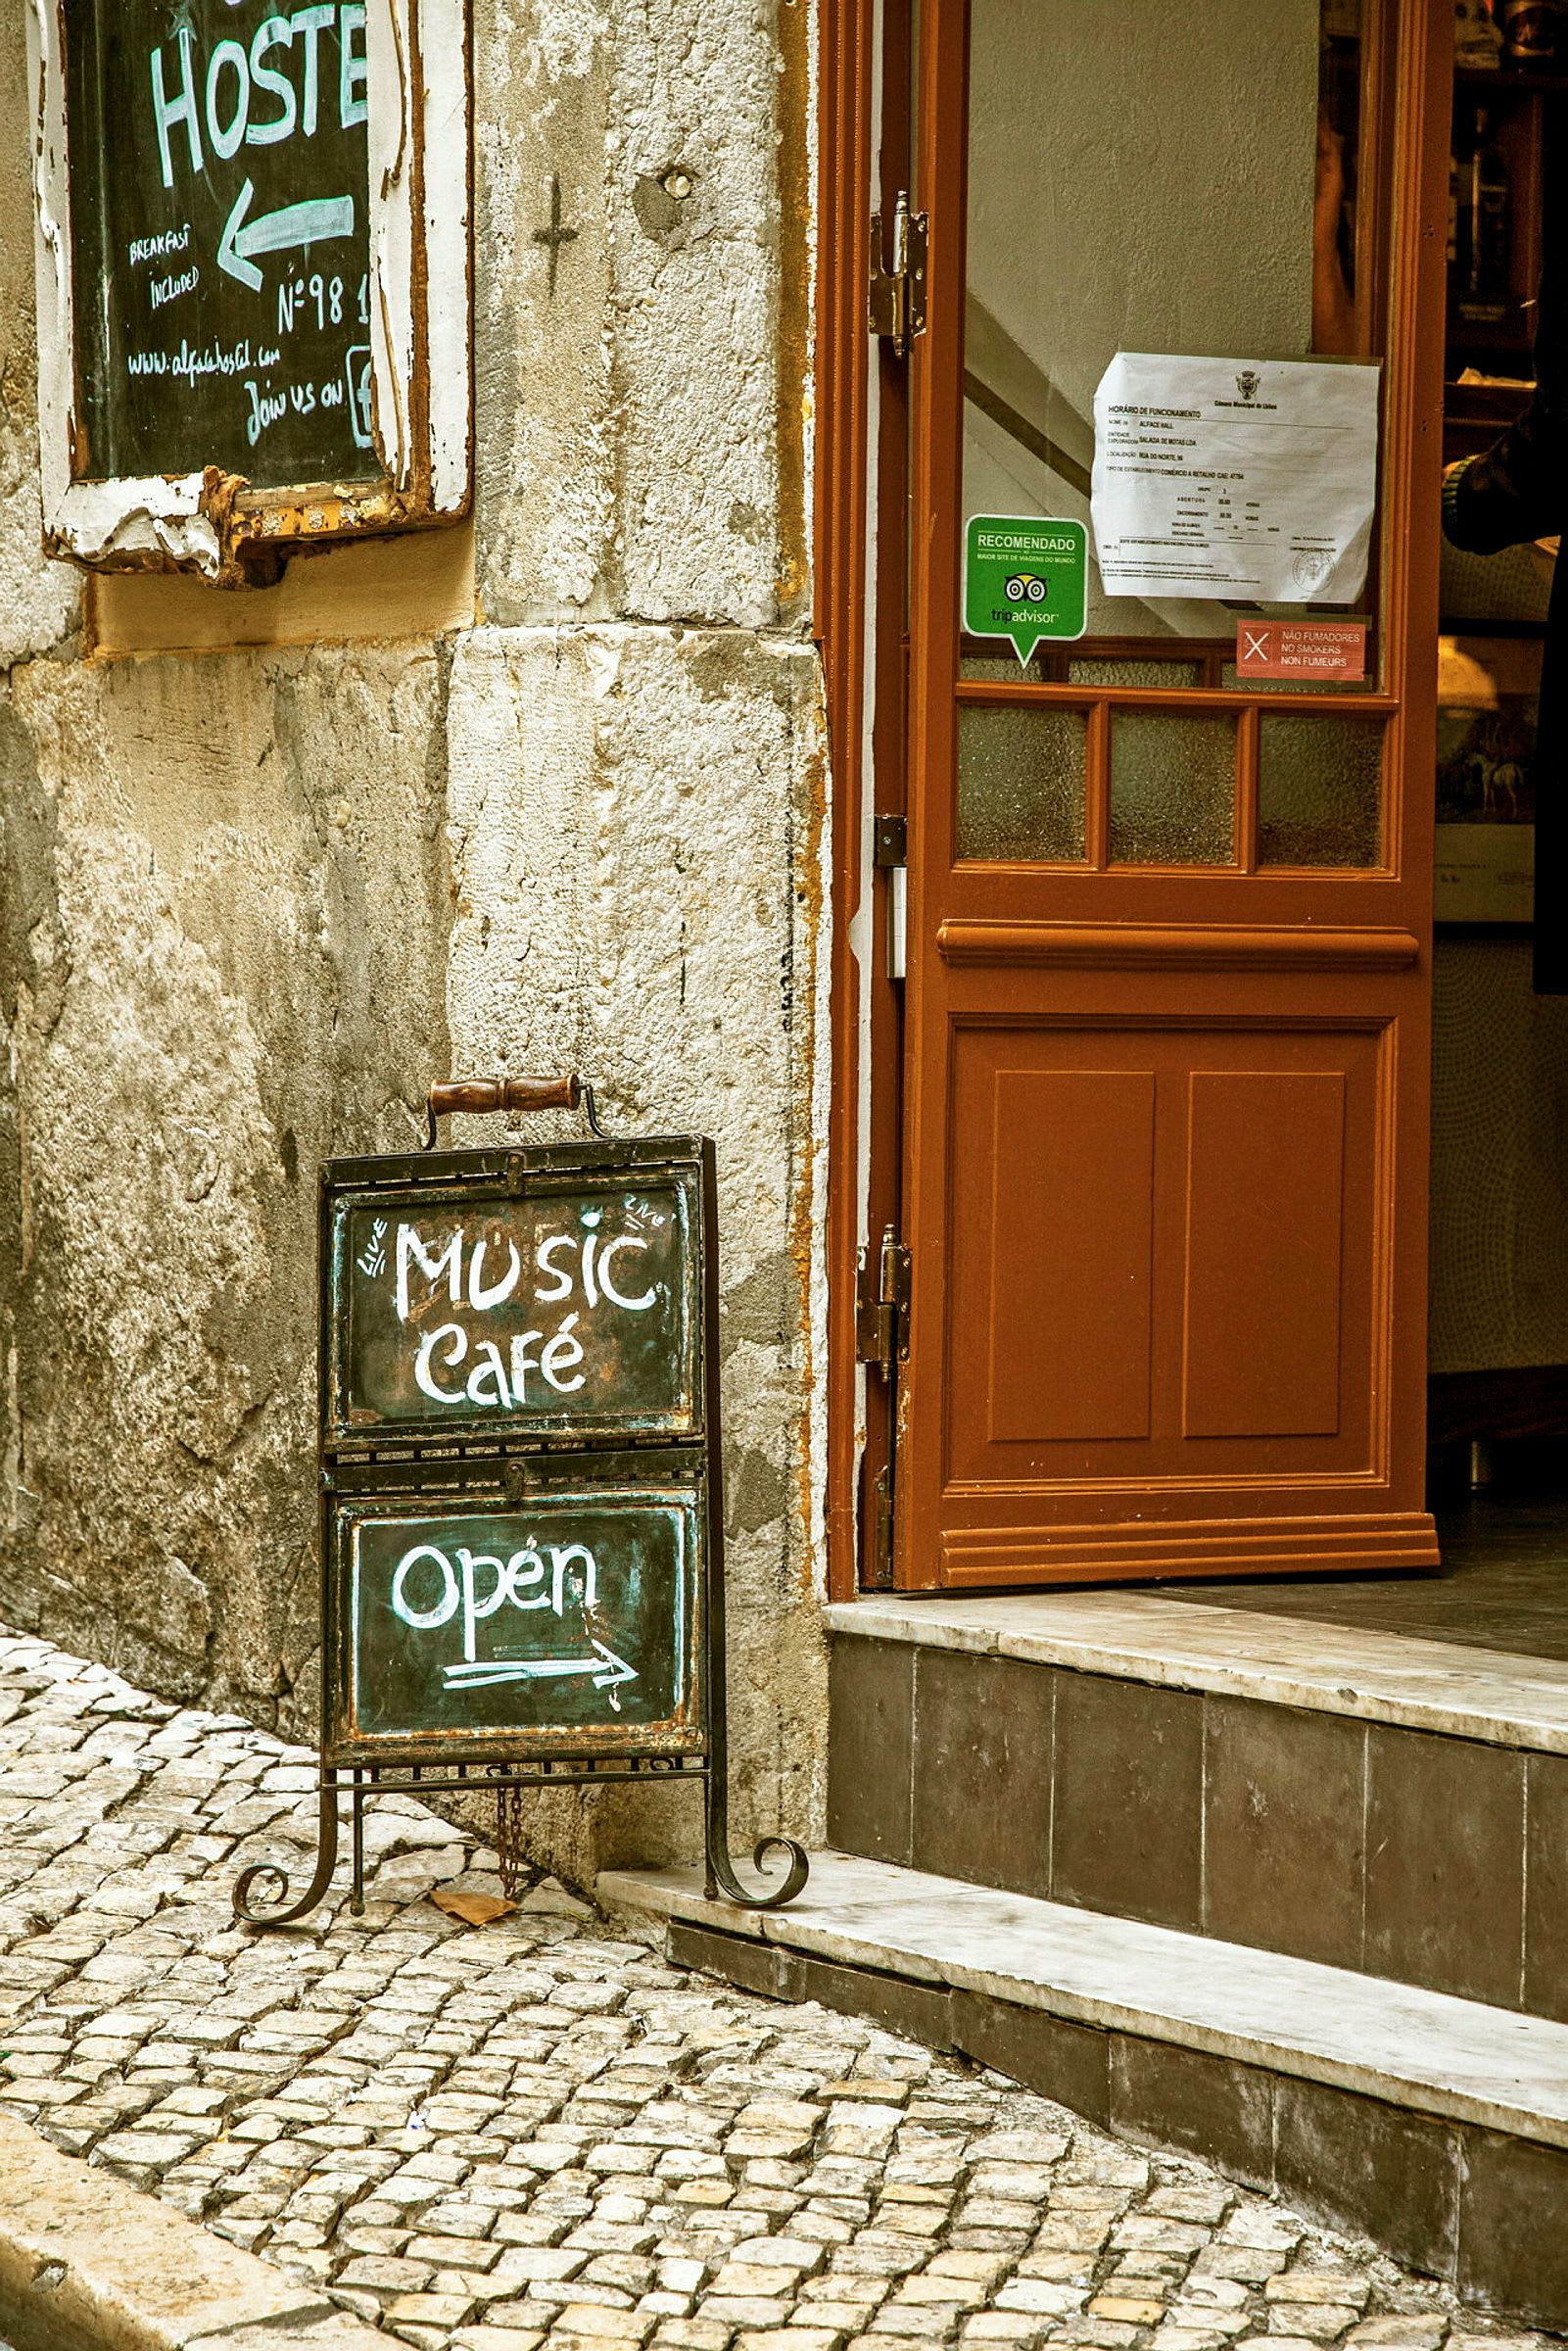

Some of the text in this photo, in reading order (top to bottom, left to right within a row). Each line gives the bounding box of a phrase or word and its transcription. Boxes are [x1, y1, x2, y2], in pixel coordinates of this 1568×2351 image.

[129, 223, 191, 266] BREAKFAST
[151, 265, 200, 310] INCLUDED
[320, 379, 343, 408] ON
[1108, 404, 1202, 418] HORÁRIO DE FUNCIONAMENTO
[977, 534, 1075, 551] RECOMENDADO
[992, 608, 1057, 624] tripadvisor
[1282, 630, 1359, 643] NÃO FUMADORES
[1281, 644, 1342, 654] NO SMOKERS
[1280, 656, 1348, 666] NON FUMEURS
[356, 1218, 388, 1275] LIVE
